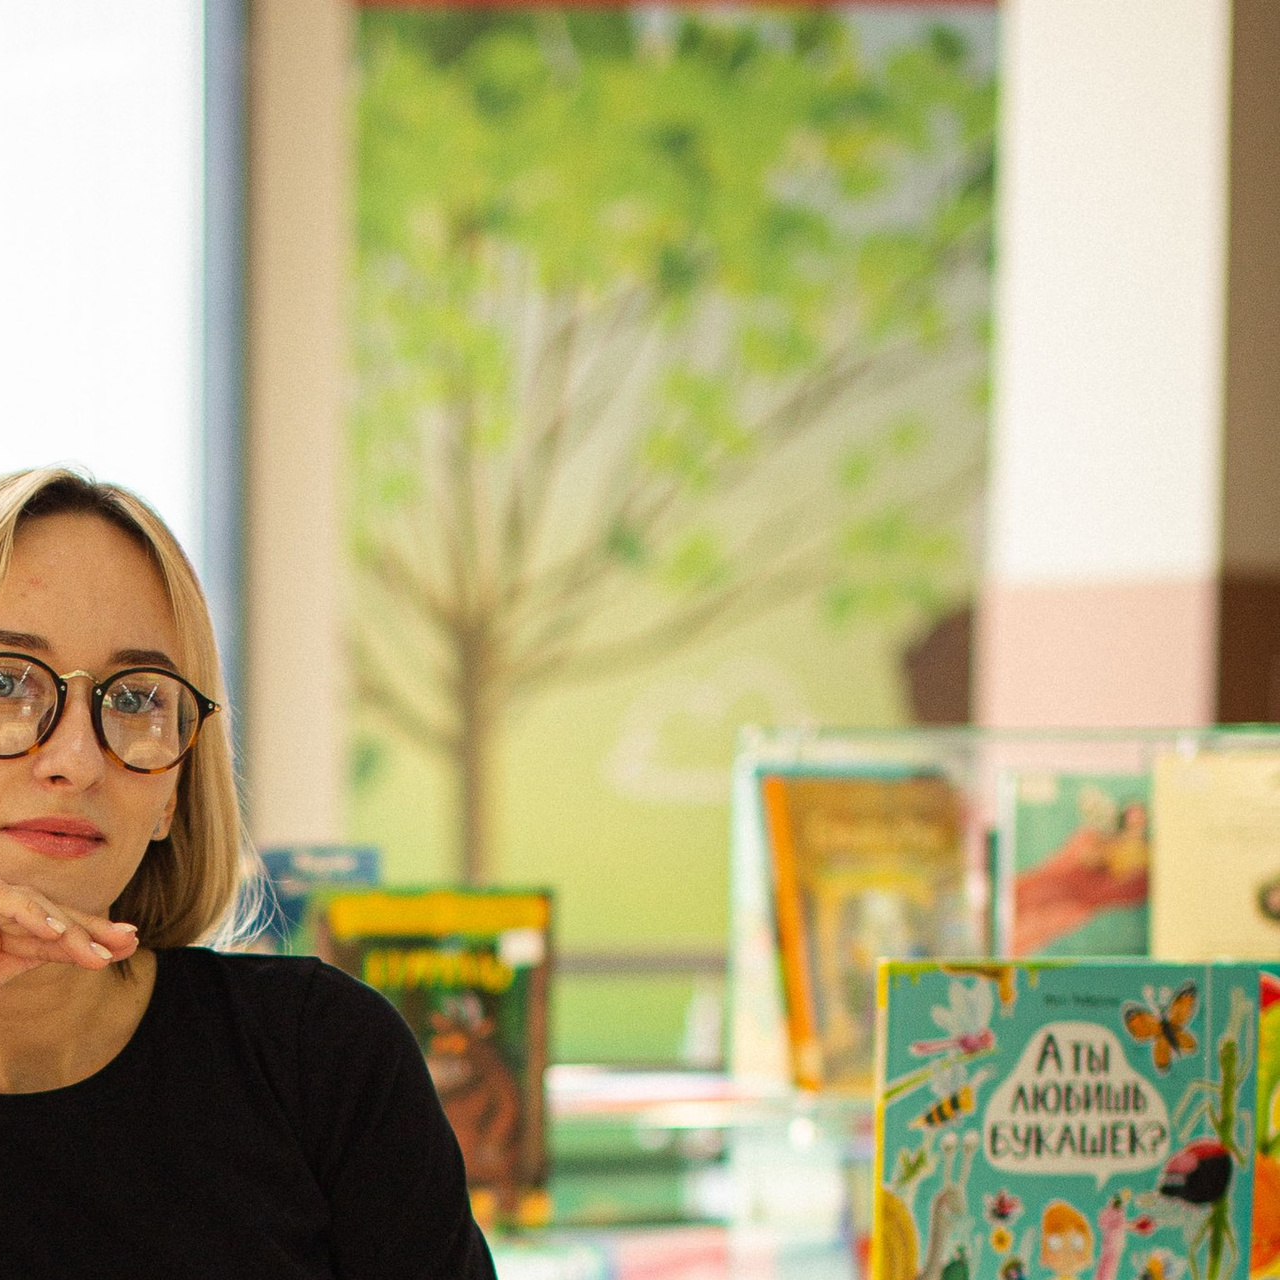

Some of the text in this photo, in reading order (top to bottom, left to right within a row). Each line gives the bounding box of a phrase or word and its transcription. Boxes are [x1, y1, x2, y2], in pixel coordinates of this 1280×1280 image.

[1037, 1033, 1110, 1074] А ТЫ
[1011, 1080, 1148, 1115] ЛЮБИШЬ
[989, 1121, 1167, 1157] БУКАШЕК?
